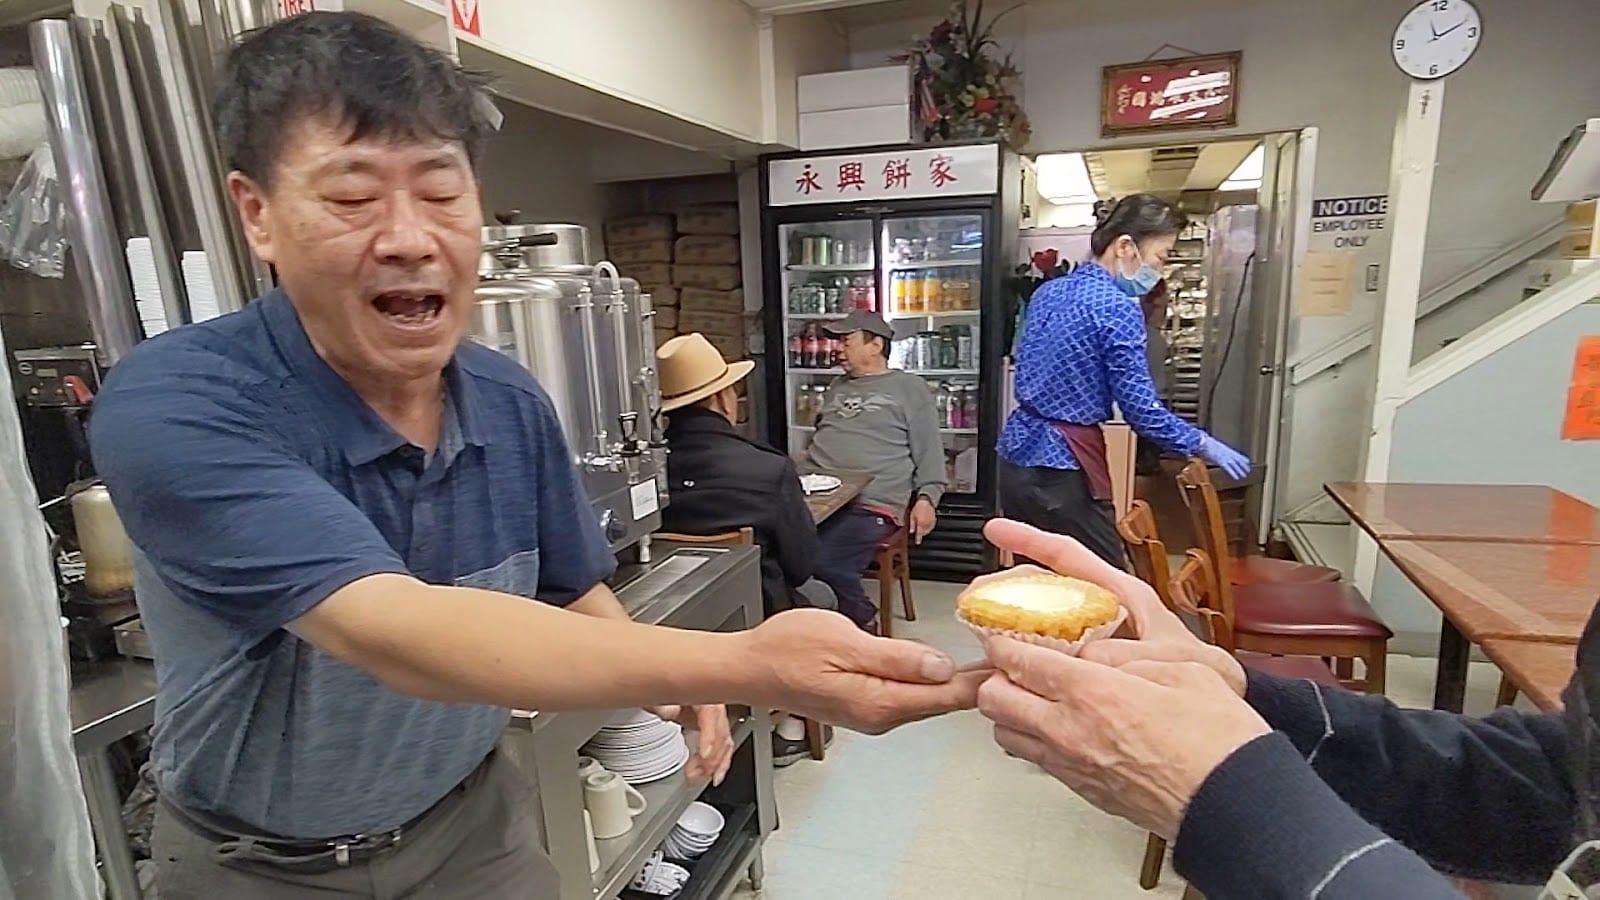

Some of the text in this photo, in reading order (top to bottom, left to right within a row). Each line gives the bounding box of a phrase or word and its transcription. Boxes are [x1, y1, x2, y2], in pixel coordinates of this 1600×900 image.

[277, 0, 307, 16] IRE
[1430, 0, 1448, 12] 12
[1467, 26, 1478, 39] 3
[1396, 39, 1406, 50] 9
[1429, 64, 1439, 76] 6
[795, 153, 958, 195] 永興餅家
[1318, 198, 1388, 216] NOTICE
[1334, 236, 1370, 249] ONLY
